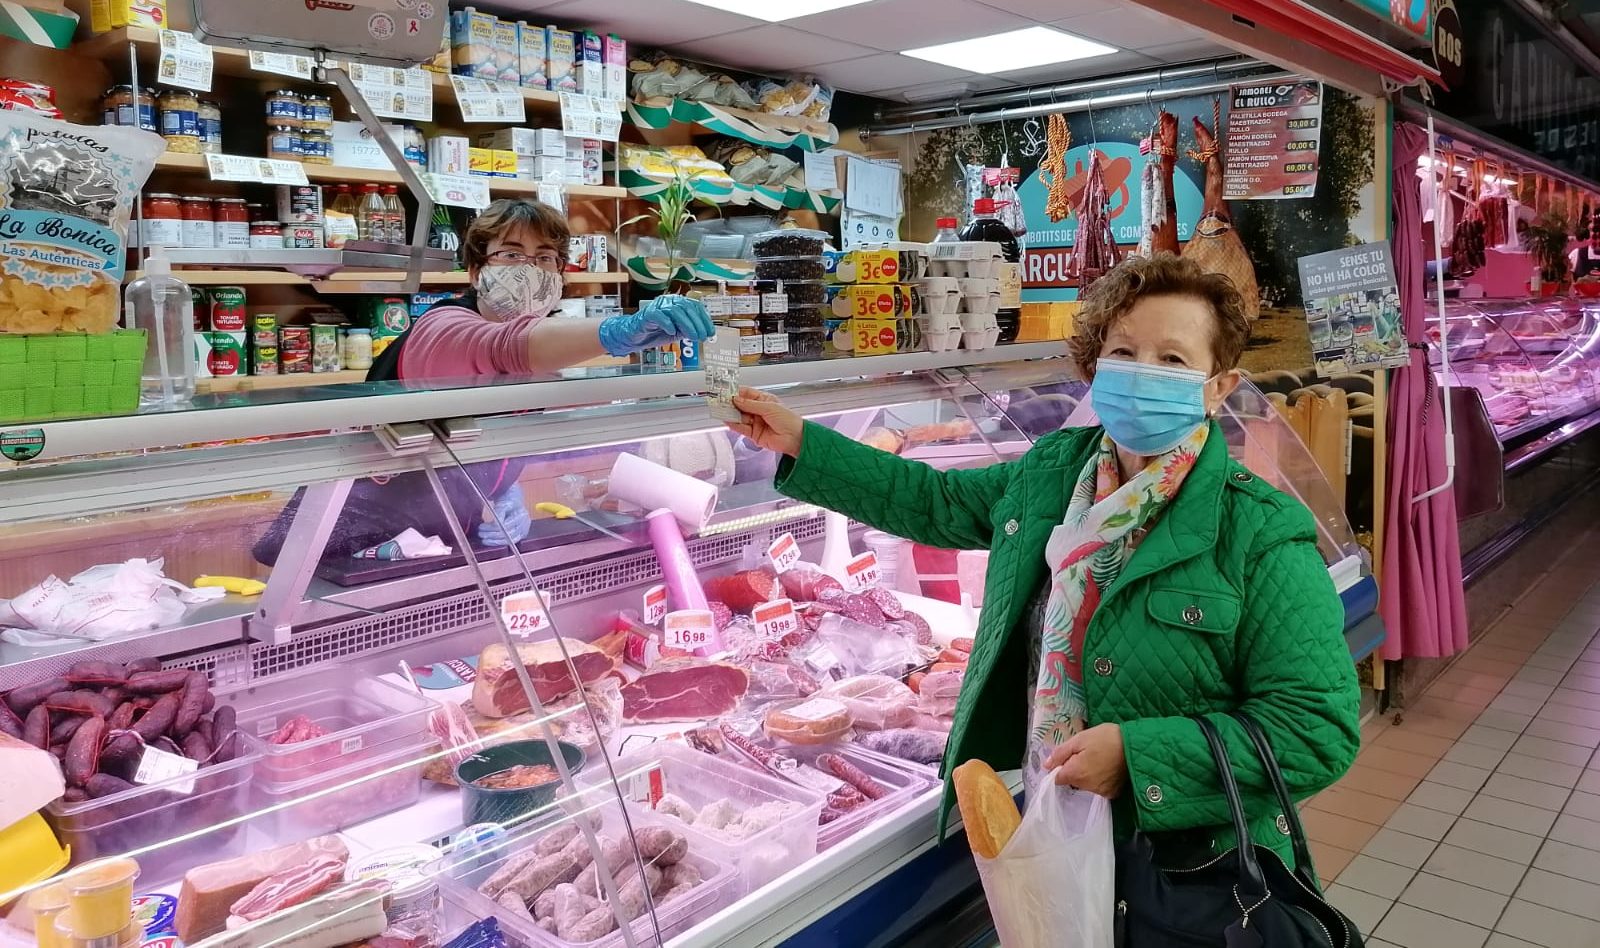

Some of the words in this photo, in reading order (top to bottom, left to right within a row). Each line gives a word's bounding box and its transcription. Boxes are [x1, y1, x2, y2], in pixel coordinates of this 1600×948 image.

[1438, 26, 1461, 67] ROS
[1234, 99, 1244, 108] EL
[1246, 97, 1275, 107] RULLO
[0, 214, 27, 239] La
[36, 217, 116, 256] Bonica
[3, 244, 25, 257] Las
[1339, 252, 1368, 268] SENSE
[1369, 250, 1384, 262] TU
[862, 262, 880, 280] 3€
[1306, 275, 1321, 286] NO
[1323, 272, 1335, 283] HI
[1336, 269, 1351, 281] HA
[1353, 263, 1386, 278] COLOR
[857, 297, 877, 316] 3€
[858, 331, 878, 349] 3€
[764, 620, 790, 636] 19,98
[674, 630, 706, 645] 16,98
